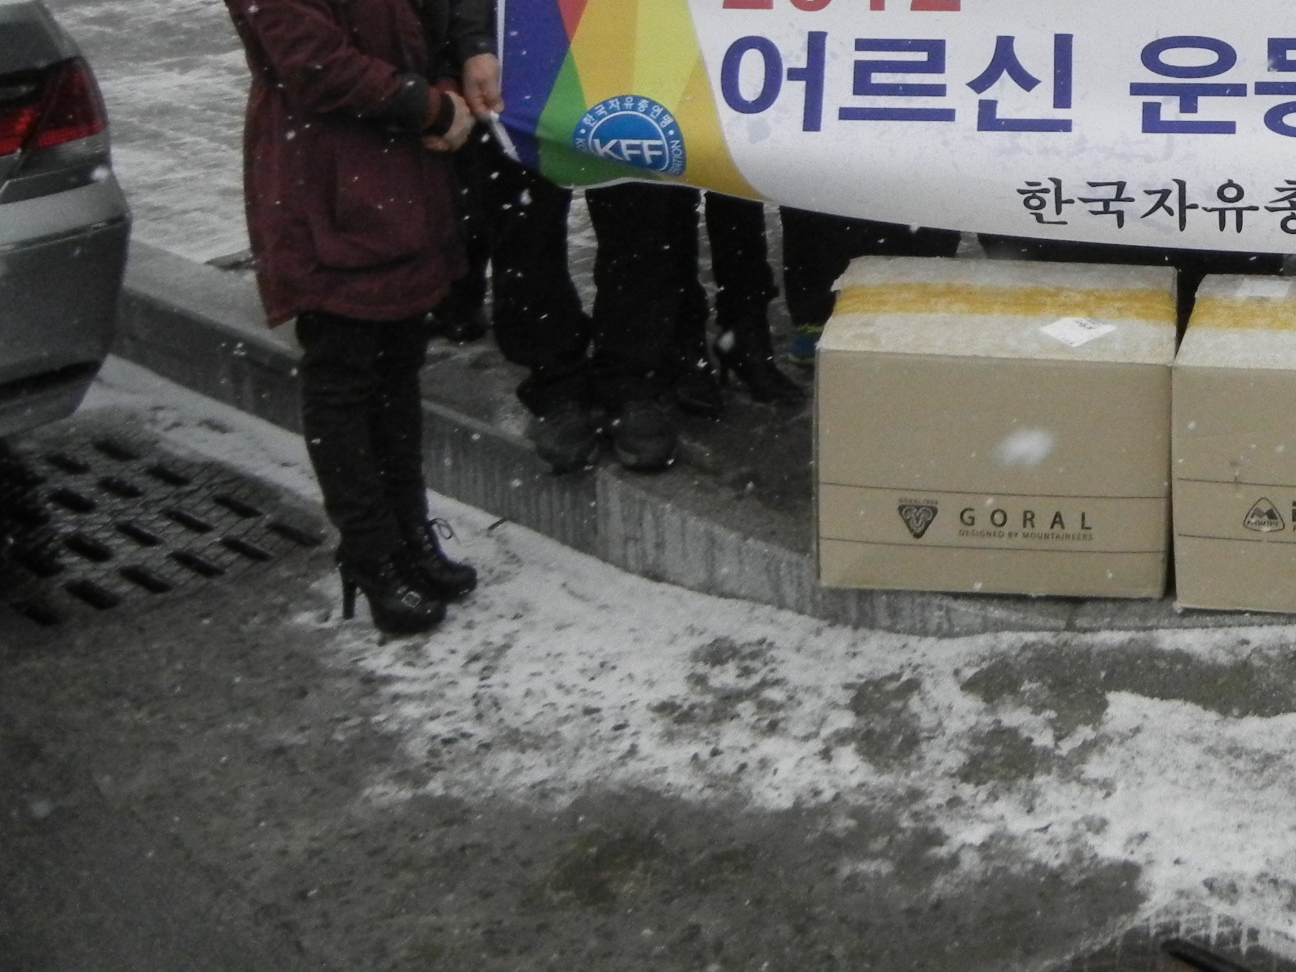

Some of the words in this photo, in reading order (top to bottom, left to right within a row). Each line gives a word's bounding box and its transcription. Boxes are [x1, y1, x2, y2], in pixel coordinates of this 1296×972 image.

[720, 31, 1076, 134] 어르신
[582, 96, 674, 128] 한국자유총연맹
[594, 138, 663, 165] KFF
[959, 507, 1093, 531] GORAL
[957, 529, 1005, 539] DESIGNED
[1006, 530, 1019, 539] BY
[1022, 531, 1094, 542] MOUNTAINEERS
